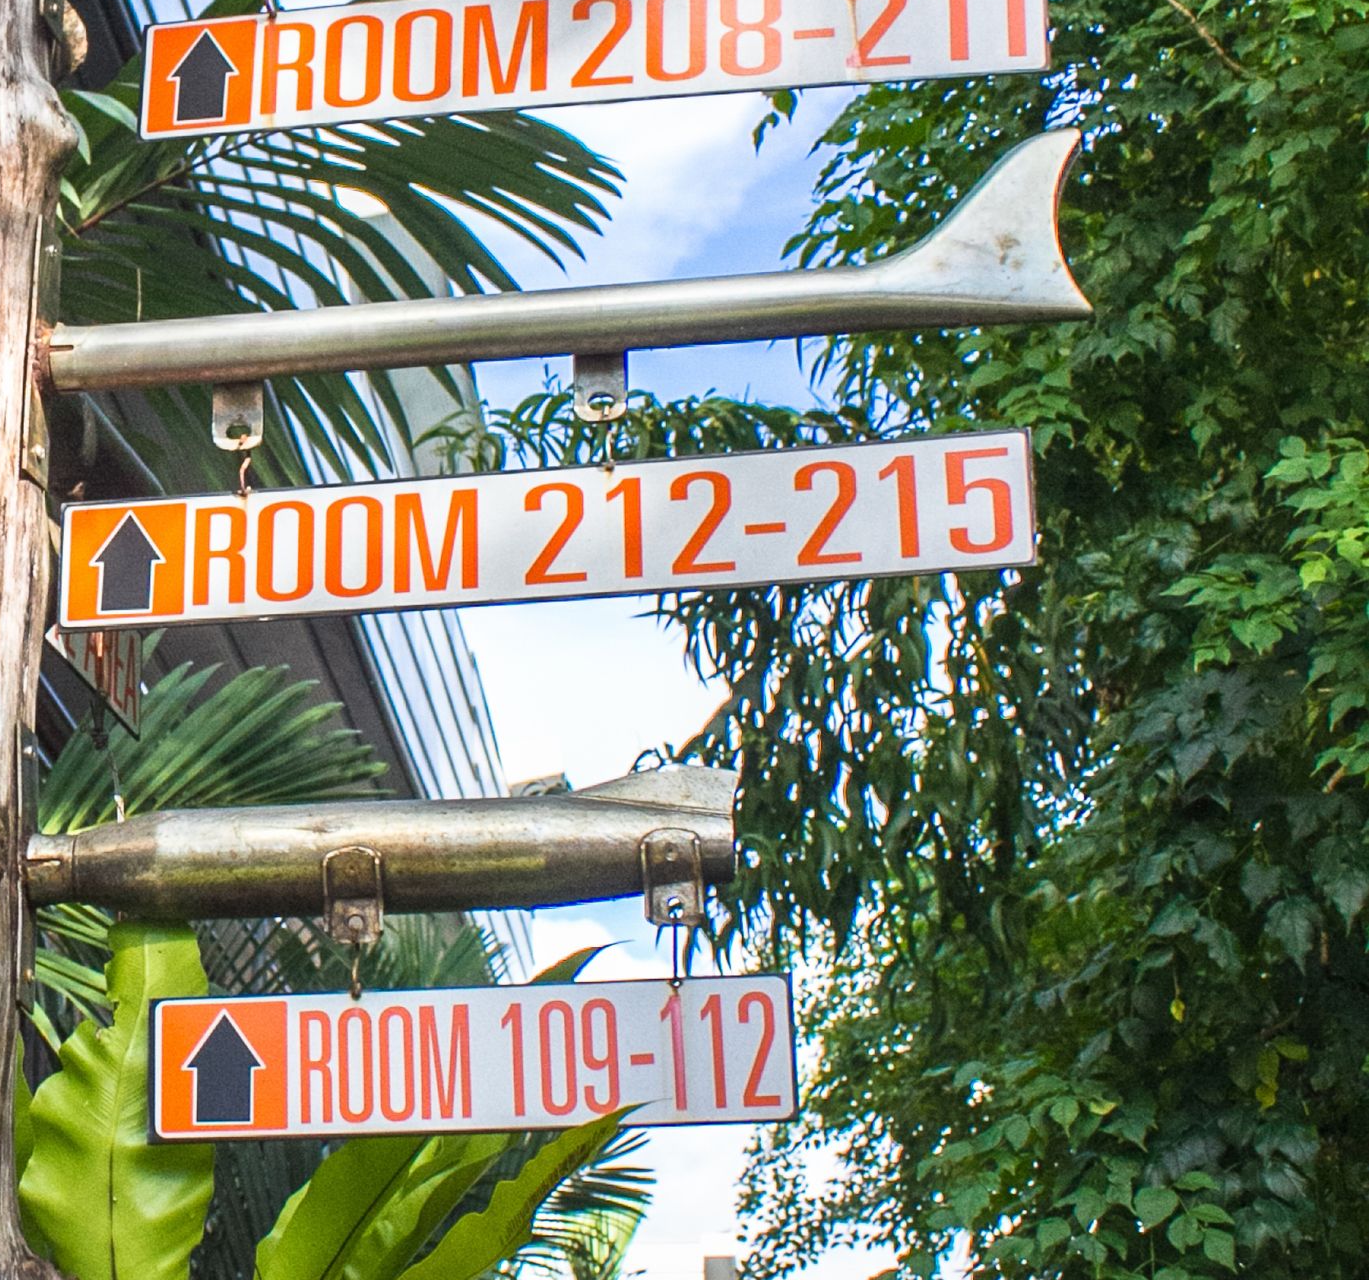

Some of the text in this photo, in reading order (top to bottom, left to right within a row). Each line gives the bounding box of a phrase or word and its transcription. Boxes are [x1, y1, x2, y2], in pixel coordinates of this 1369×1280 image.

[192, 447, 1013, 606] ROOM 212-215
[299, 991, 781, 1125] ROOM 109-112
